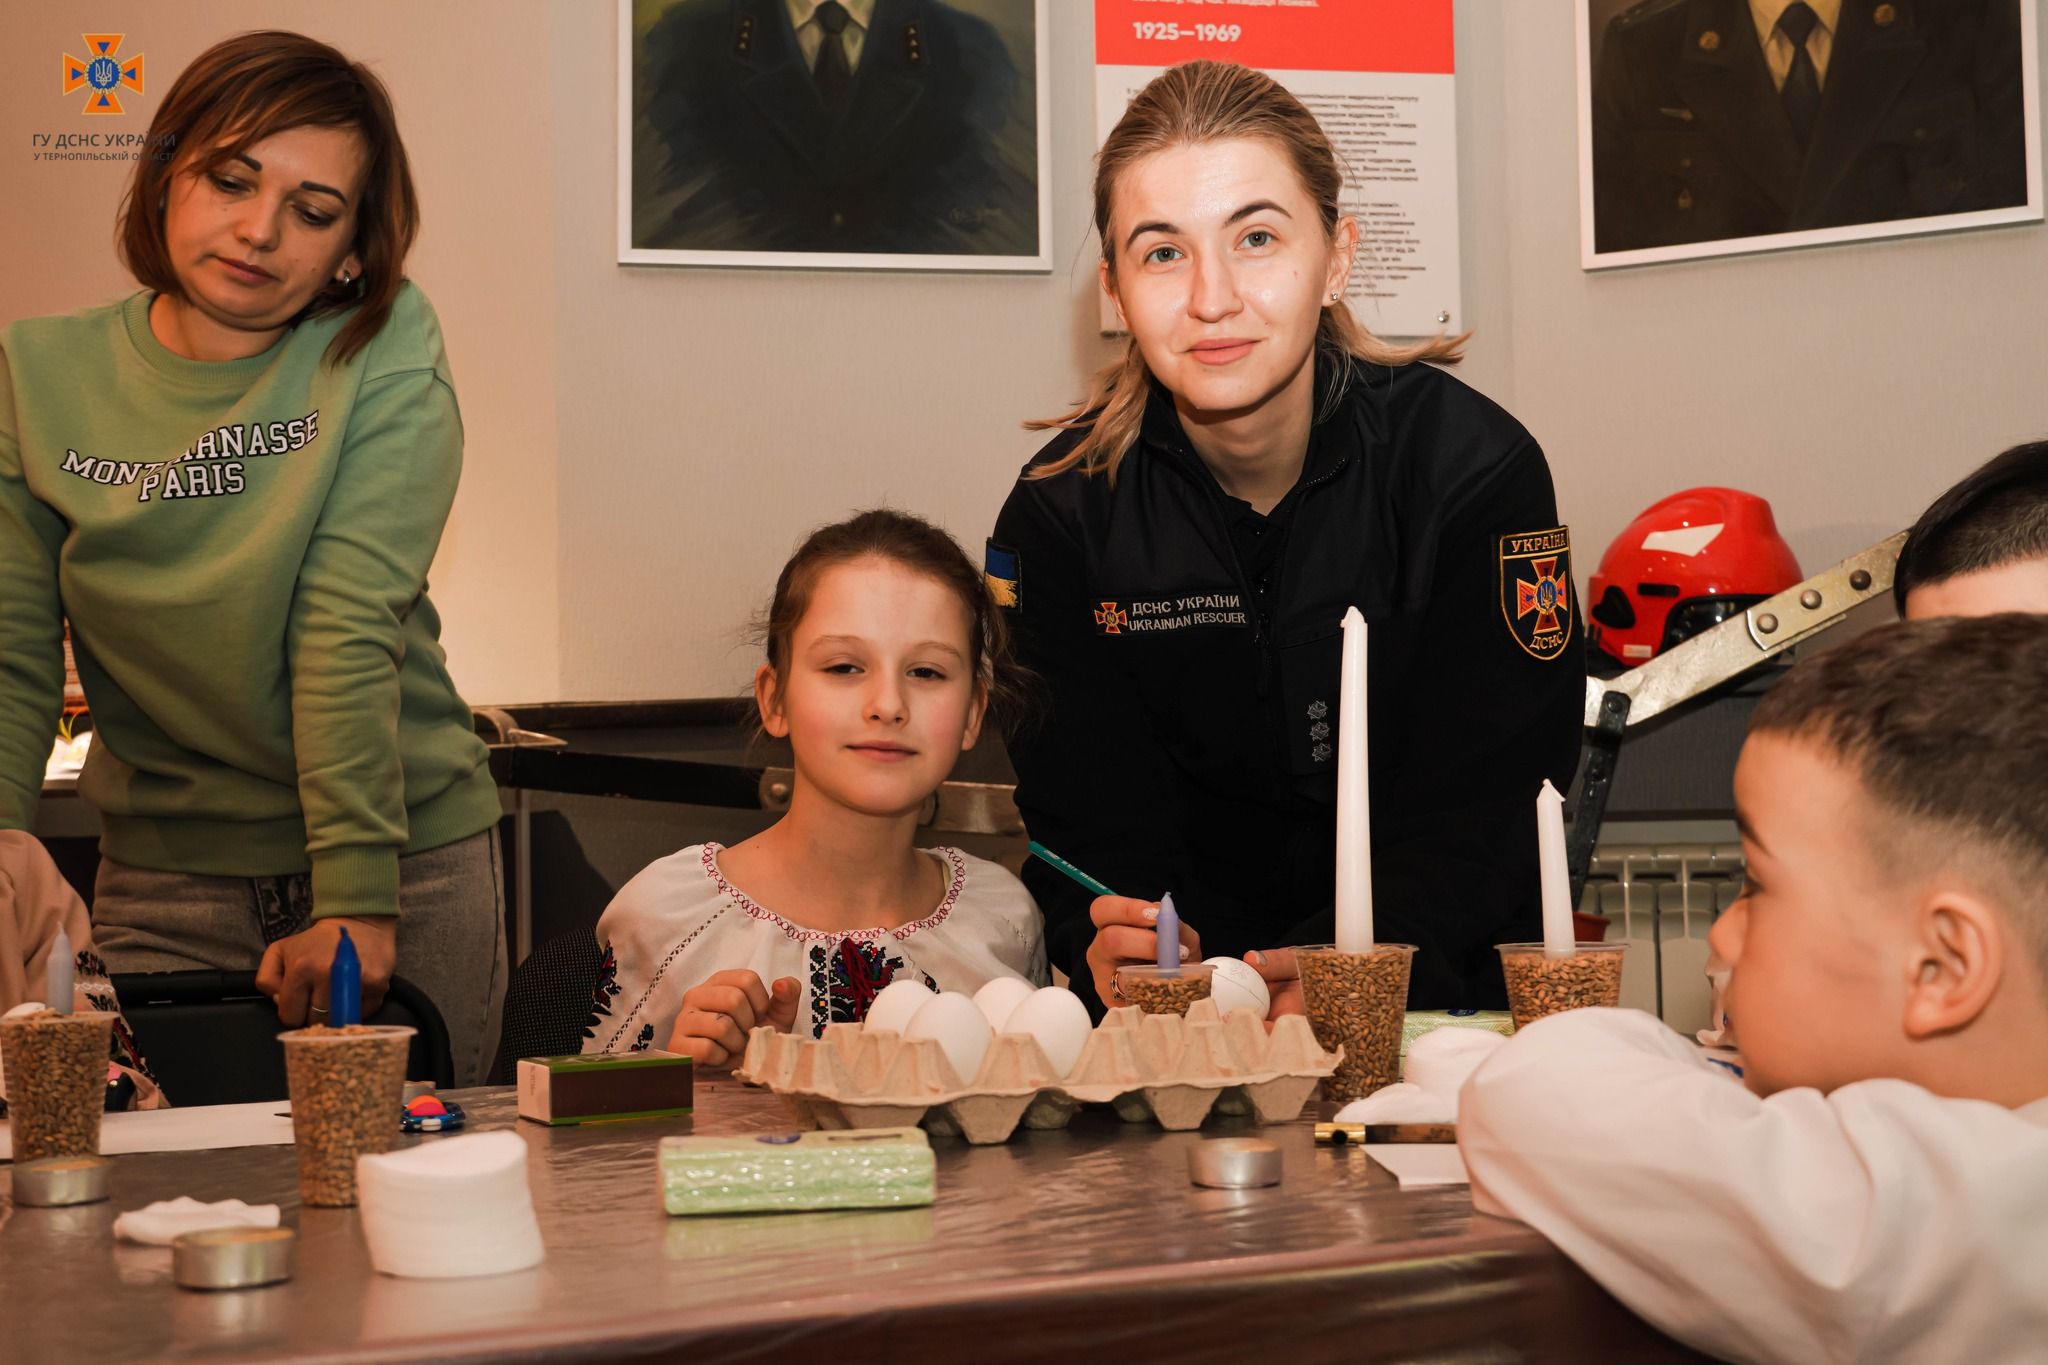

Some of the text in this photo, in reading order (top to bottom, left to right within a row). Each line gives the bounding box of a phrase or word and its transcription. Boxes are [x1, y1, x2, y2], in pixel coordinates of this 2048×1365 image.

[59, 409, 319, 485] MONTRNASSE
[138, 461, 245, 502] PARIS
[1511, 532, 1566, 553] УКРАЇНА
[1132, 594, 1240, 616] ДСНС УКРАЇНИ
[1128, 612, 1247, 631] UKRAINIAN RESCUER
[1529, 631, 1564, 650] ДСНС
